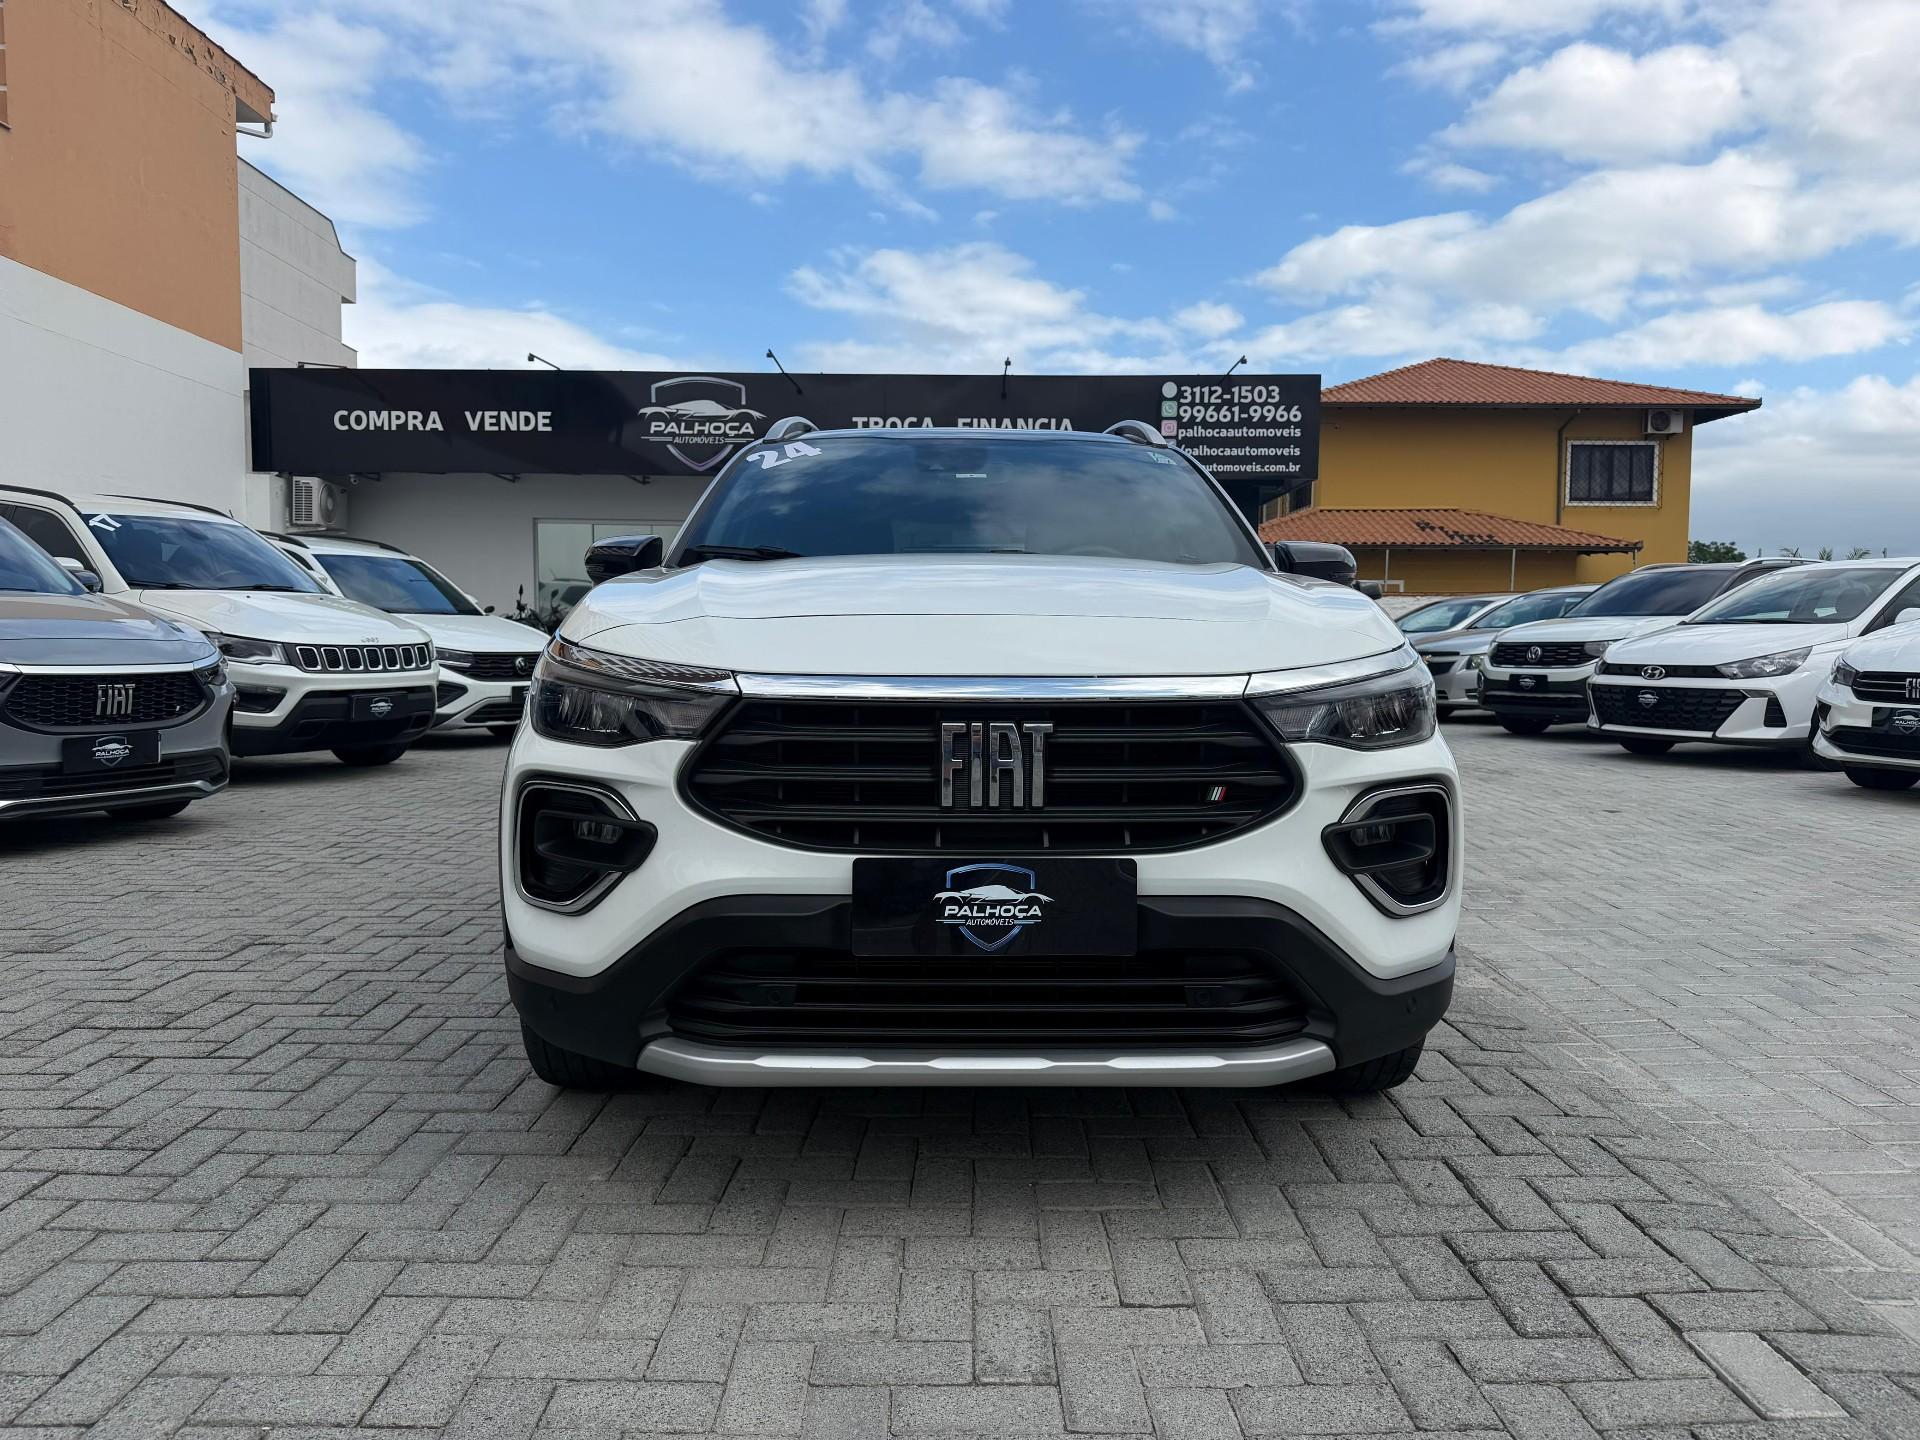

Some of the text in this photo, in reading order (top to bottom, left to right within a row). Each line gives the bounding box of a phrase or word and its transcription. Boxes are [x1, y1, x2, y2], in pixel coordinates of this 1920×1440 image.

[1179, 386, 1280, 403] 3112-1503
[333, 410, 553, 432] COMPRA VENDE
[1179, 406, 1302, 422] 99661-9966
[649, 421, 755, 437] PALHOÇA
[1178, 425, 1302, 440] palhocaautomoveis
[673, 435, 725, 444] AUTOMÓVEIS
[746, 441, 822, 470] 24
[1202, 462, 1301, 472] utomoveis.com.br
[1905, 678, 1920, 698] FI
[96, 683, 136, 715] FIAT
[941, 722, 1054, 807] FIAT
[944, 905, 1042, 918] PALHOÇA
[966, 918, 1014, 926] AUTOMÓVEIS
